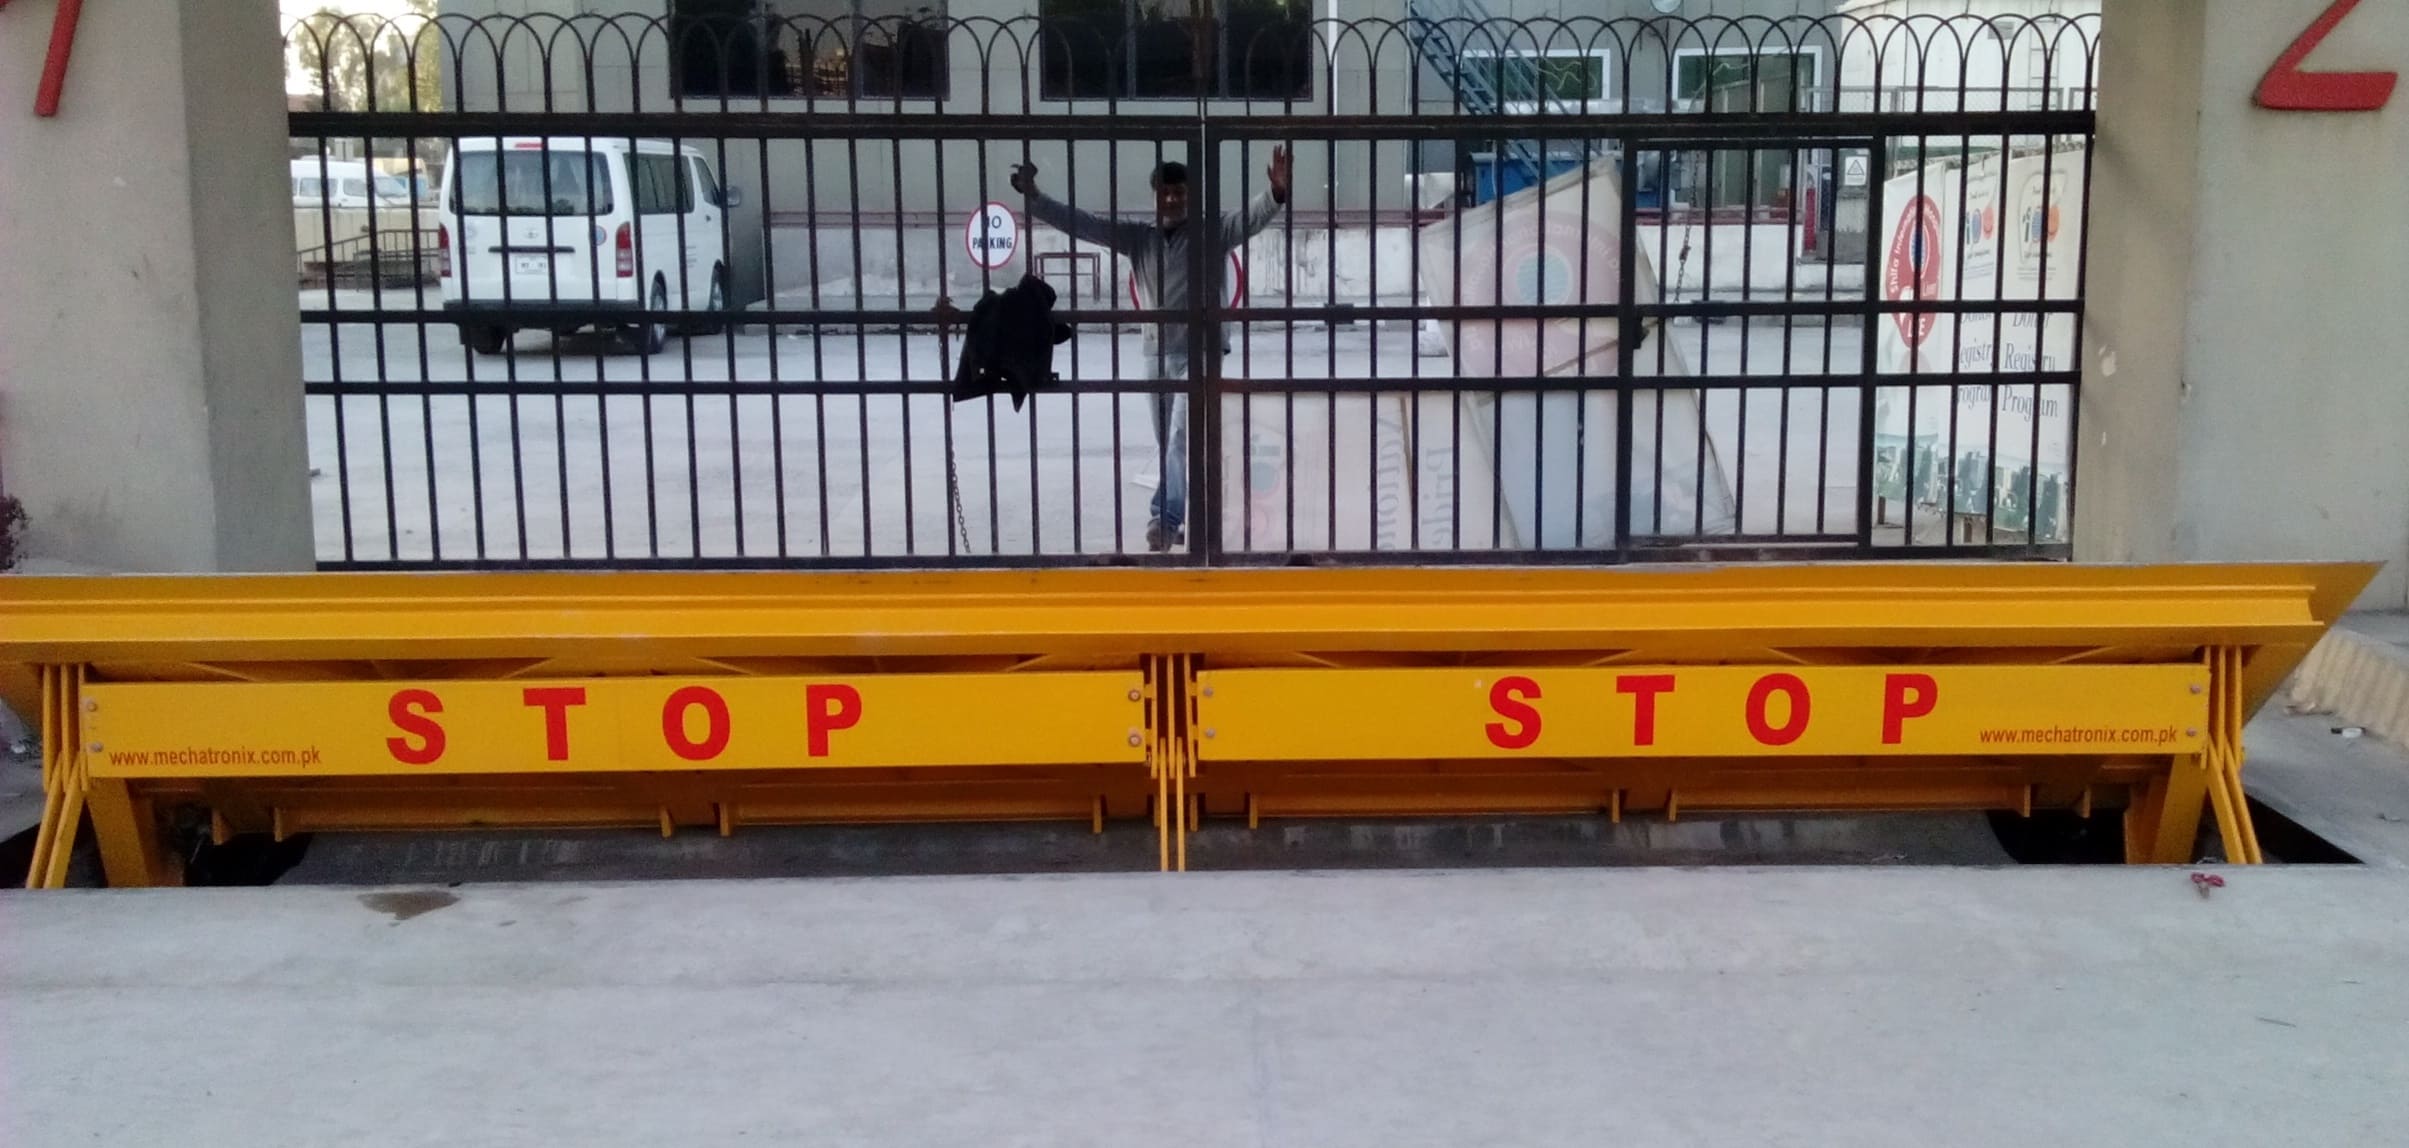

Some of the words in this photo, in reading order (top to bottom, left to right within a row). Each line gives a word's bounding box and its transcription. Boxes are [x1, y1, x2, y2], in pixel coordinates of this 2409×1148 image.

[972, 237, 1012, 249] PAKING
[2013, 312, 2053, 328] Donr
[2004, 342, 2056, 372] Regisry
[1485, 673, 1939, 749] STOP
[386, 684, 863, 764] STOP
[1979, 724, 2178, 747] www.mechatronix.com.pk
[109, 745, 322, 769] www.mechatronix.com.pk
